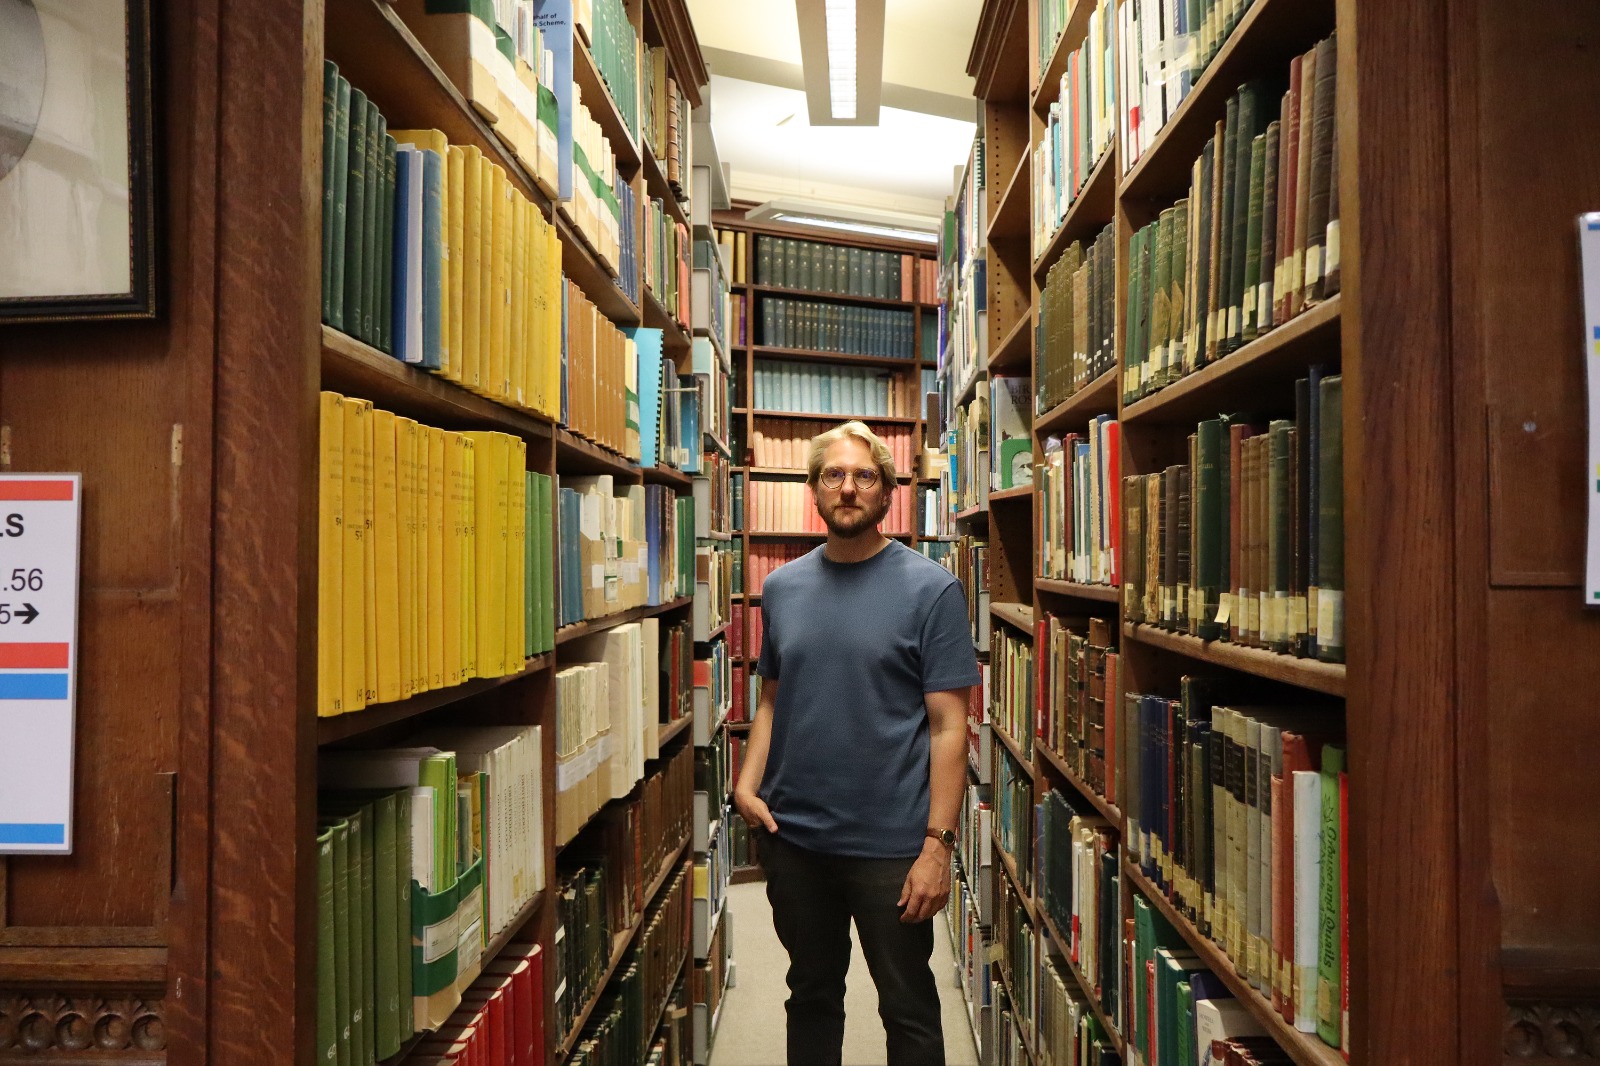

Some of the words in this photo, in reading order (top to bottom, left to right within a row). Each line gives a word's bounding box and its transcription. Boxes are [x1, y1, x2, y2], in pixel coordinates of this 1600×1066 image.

[0, 513, 25, 537] S
[1325, 883, 1335, 915] and
[1323, 916, 1336, 969] Quails
